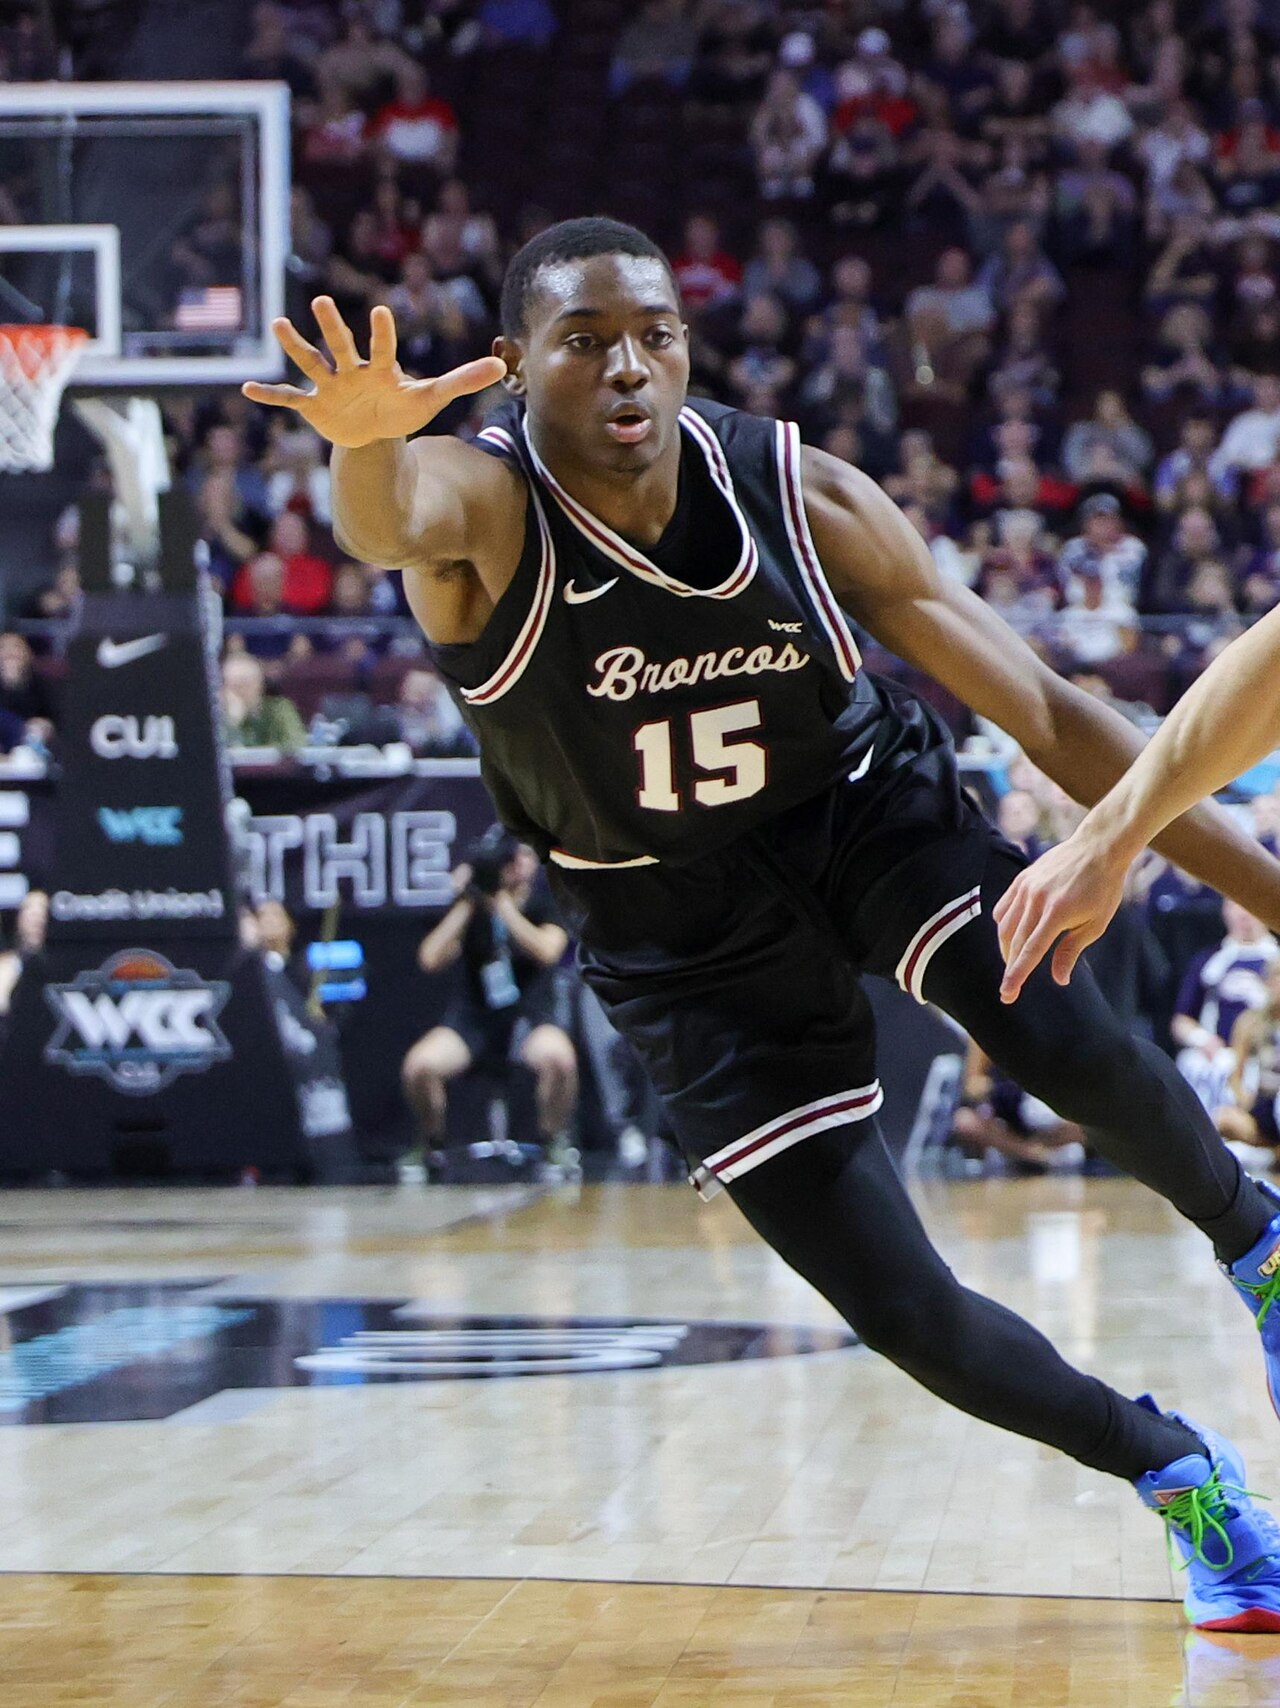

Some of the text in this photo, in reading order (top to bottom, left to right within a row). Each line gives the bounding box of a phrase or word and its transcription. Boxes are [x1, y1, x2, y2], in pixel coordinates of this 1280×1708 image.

[767, 619, 803, 634] WCC
[587, 641, 810, 702] Broncos
[632, 699, 768, 813] 15
[234, 811, 457, 909] THE
[61, 987, 215, 1053] WCC
